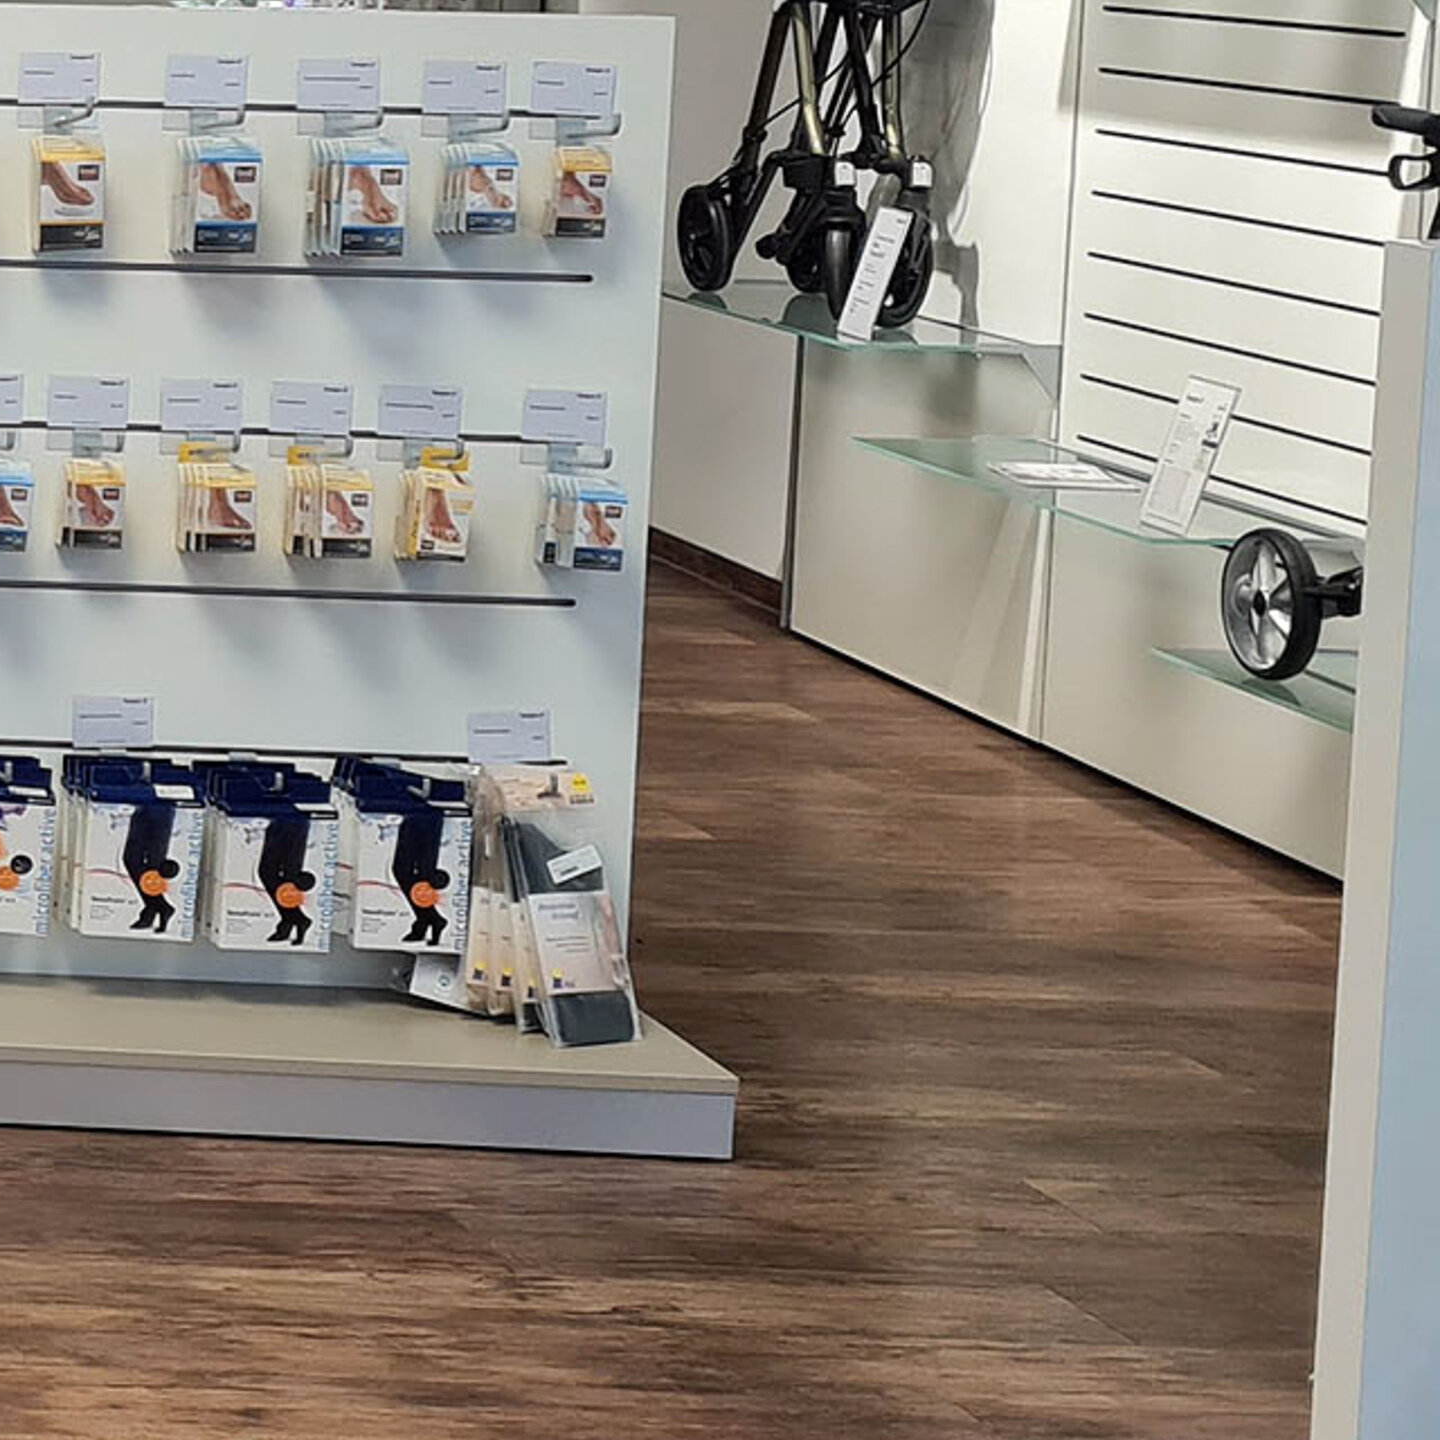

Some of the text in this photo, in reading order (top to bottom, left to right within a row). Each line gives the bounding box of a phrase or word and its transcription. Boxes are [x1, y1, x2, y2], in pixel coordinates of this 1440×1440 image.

[33, 809, 56, 934] microfiber active
[177, 812, 204, 939] microfiber active
[316, 824, 338, 950] microfiber active
[451, 821, 473, 950] microfiber active
